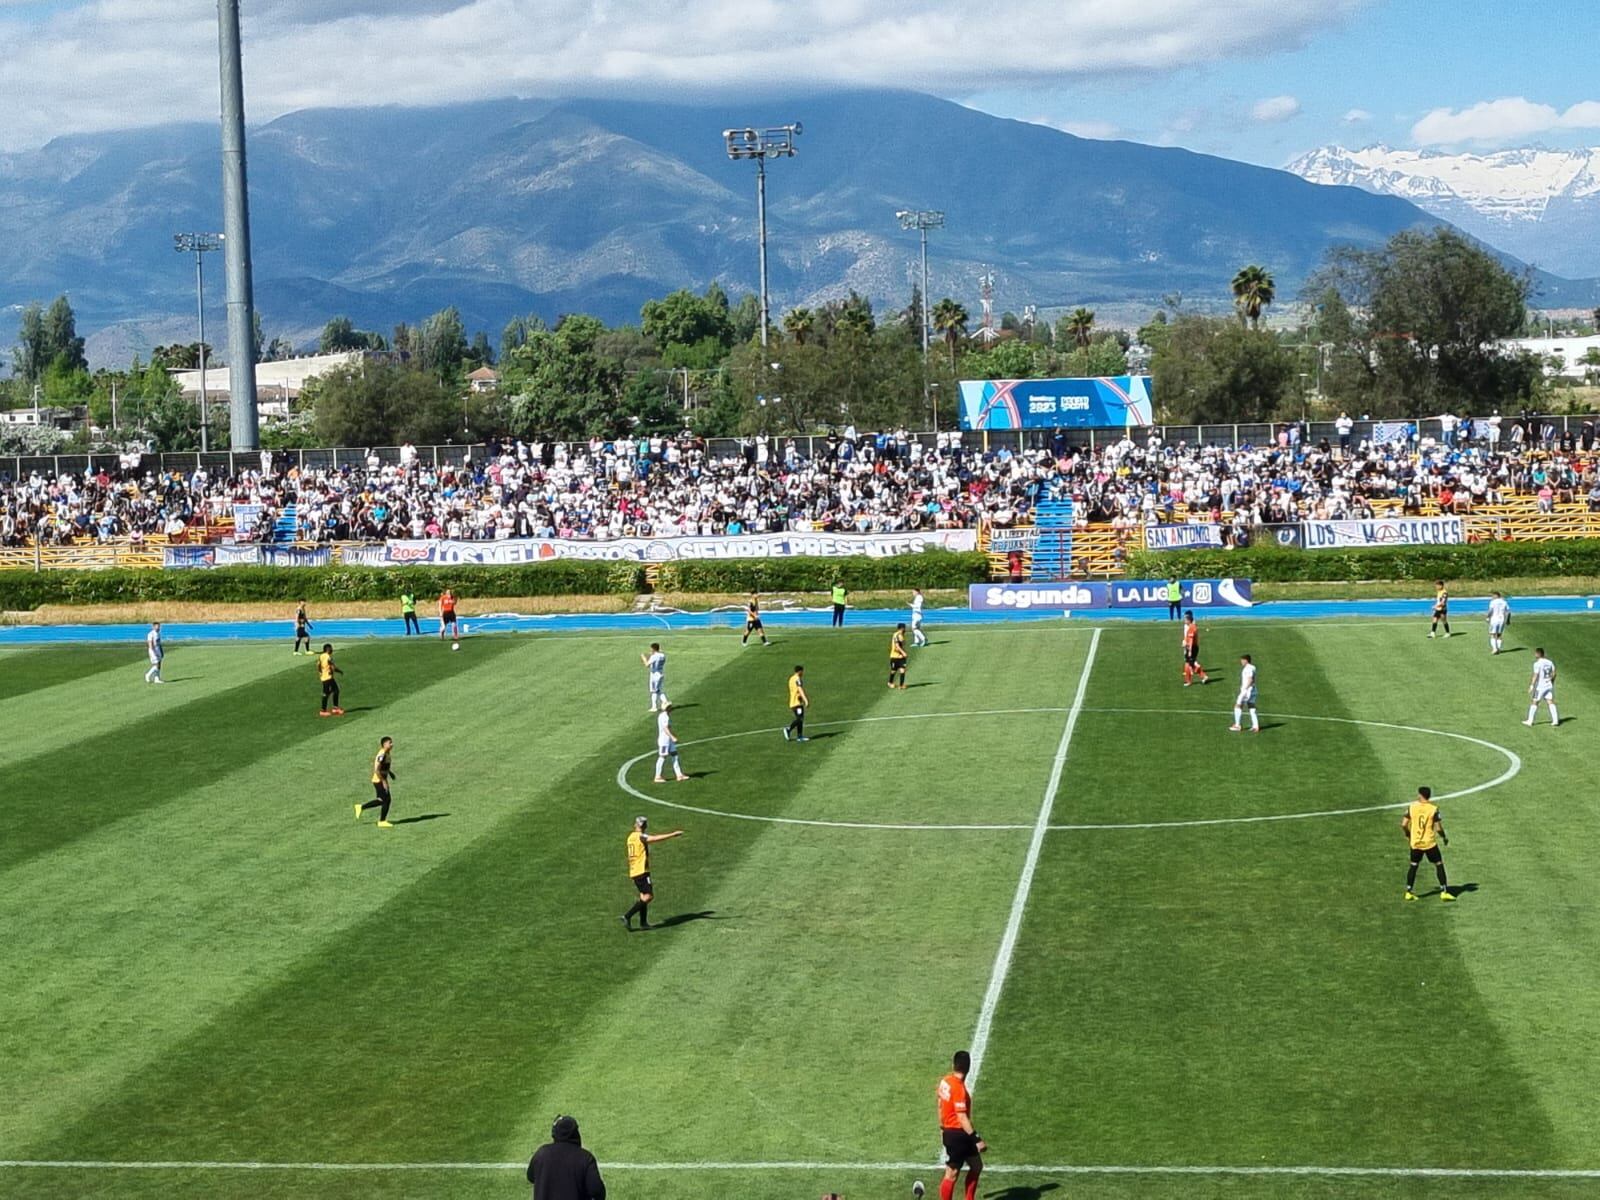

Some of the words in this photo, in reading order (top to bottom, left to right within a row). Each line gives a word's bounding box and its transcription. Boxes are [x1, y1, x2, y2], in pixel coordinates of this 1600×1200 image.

[1147, 528, 1168, 546] SAN
[1171, 526, 1210, 545] ANTONIO
[1307, 521, 1336, 545] LOS
[434, 543, 478, 564] LOS
[787, 537, 925, 556] PRESENTES
[986, 585, 1092, 608] Segunda
[1117, 588, 1142, 602] LA
[1143, 586, 1170, 602] LIG
